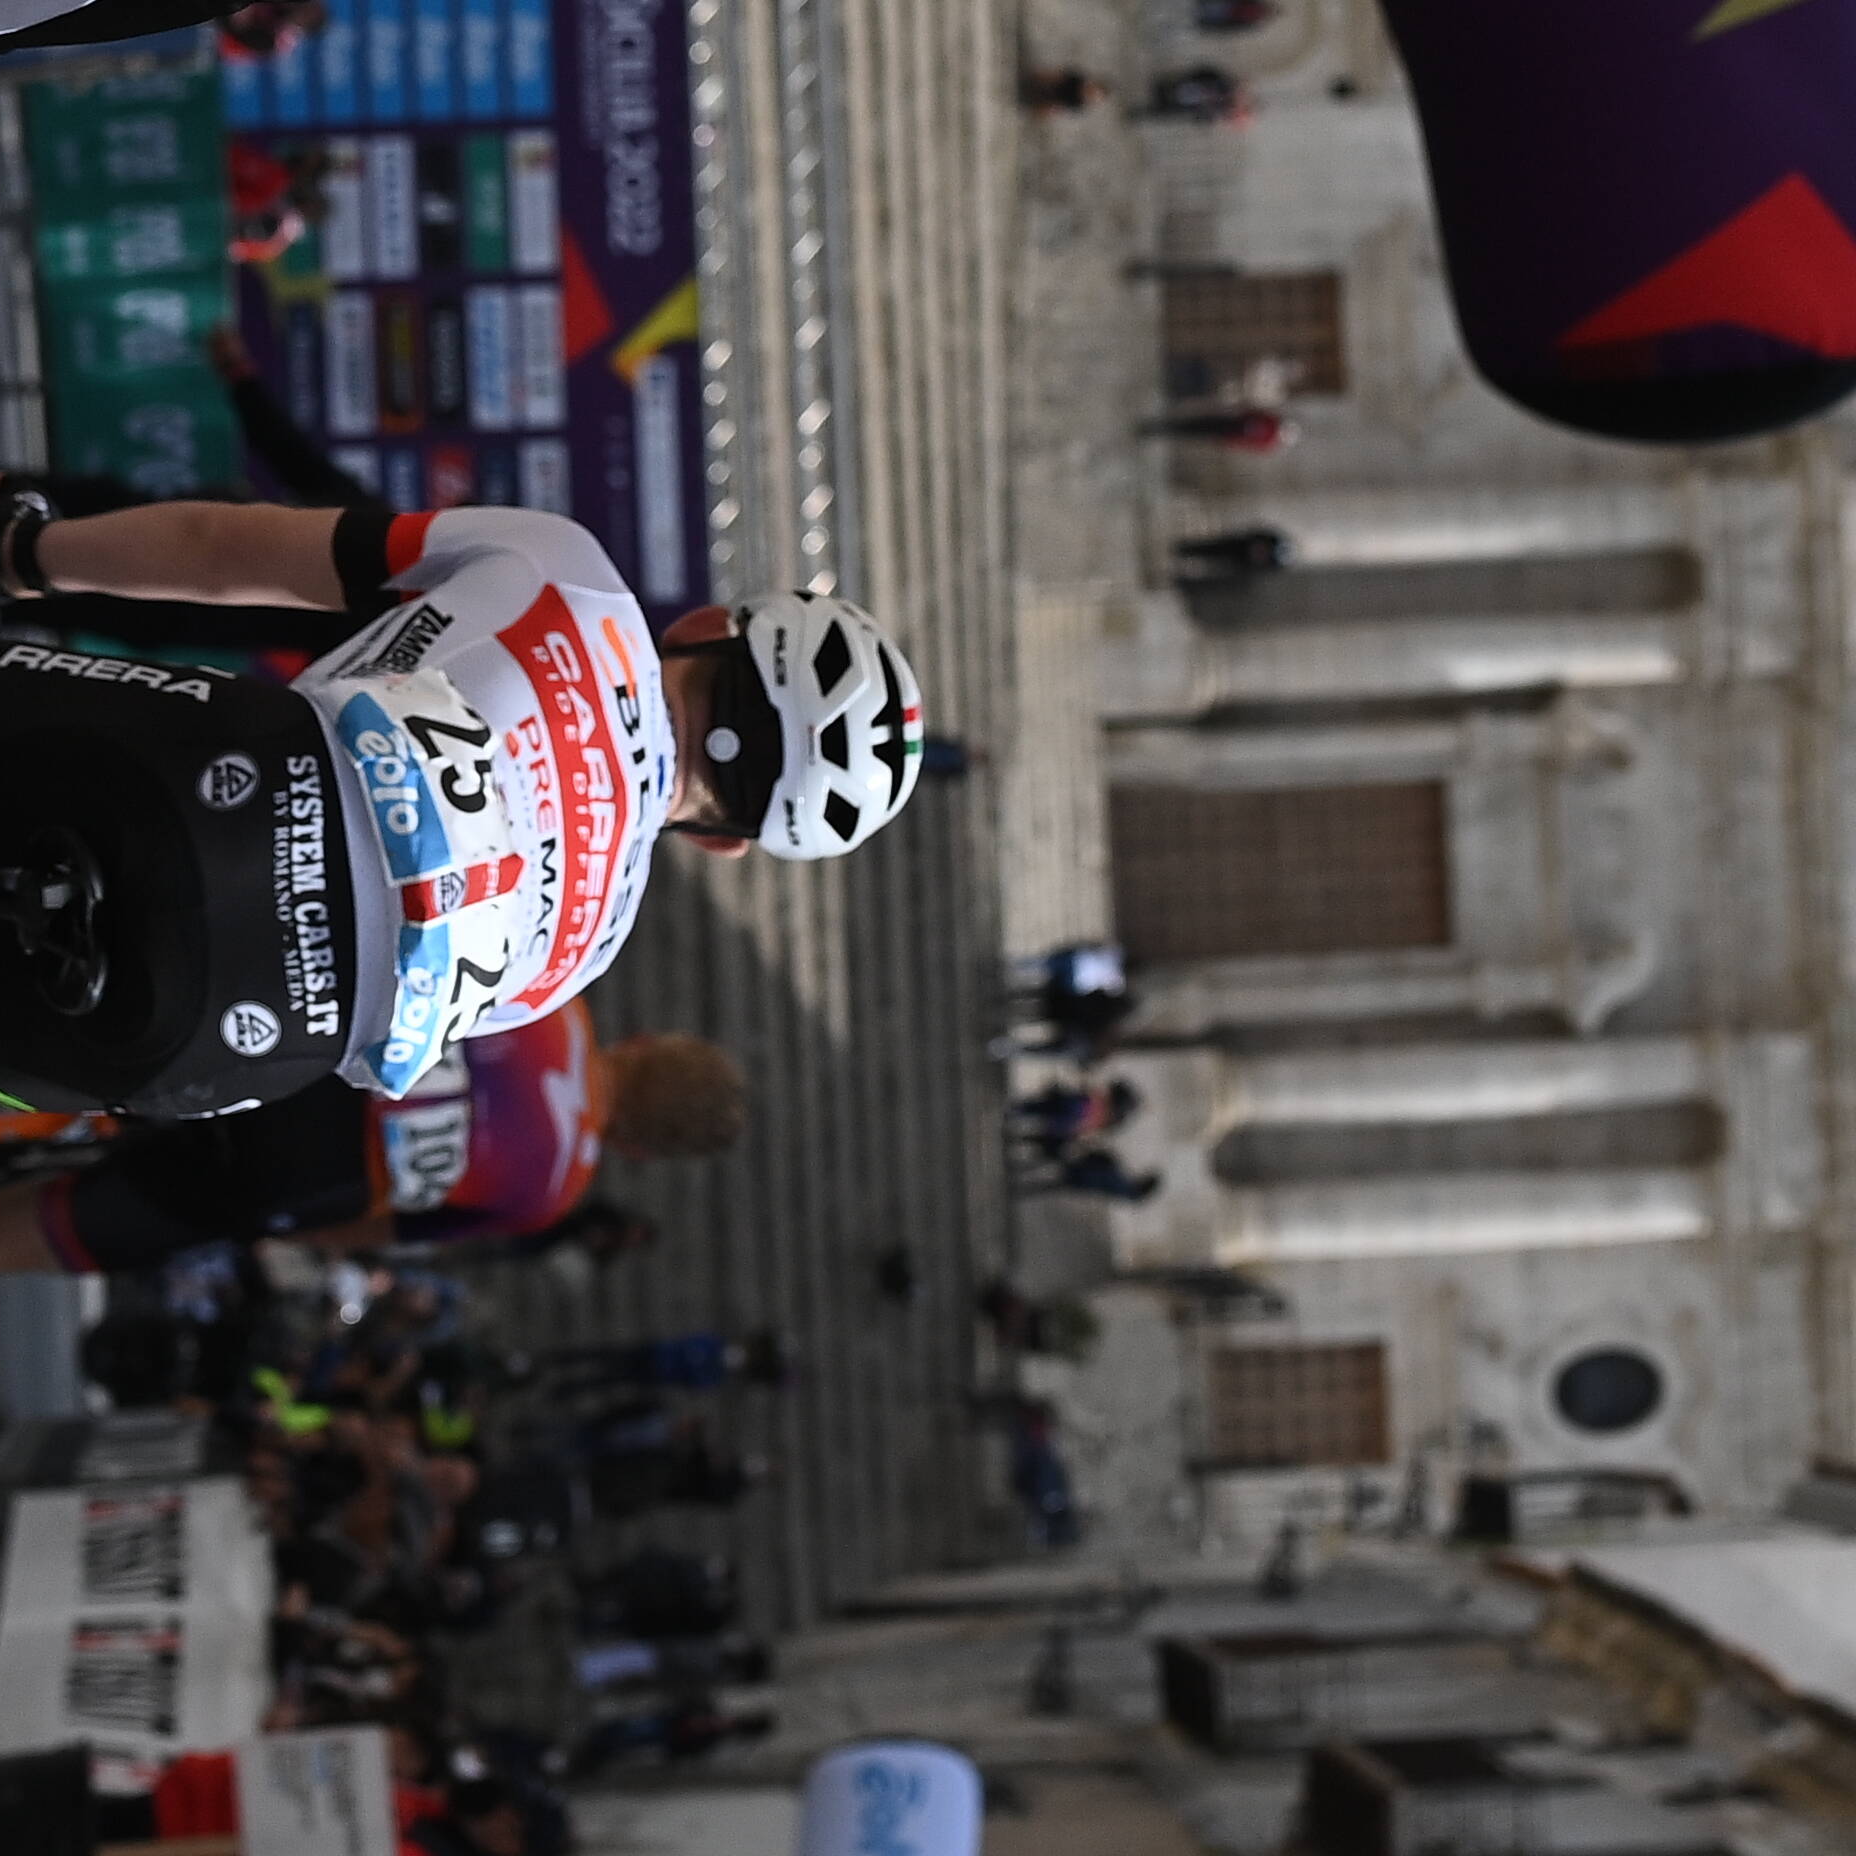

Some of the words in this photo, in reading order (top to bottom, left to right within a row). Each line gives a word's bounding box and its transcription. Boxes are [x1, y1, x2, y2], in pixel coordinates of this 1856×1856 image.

[403, 706, 492, 813] 25
[530, 644, 575, 745] RIDE
[286, 755, 326, 895] SYSTEM
[517, 716, 557, 957] PREMAC
[525, 631, 616, 992] CARRERA
[272, 791, 290, 818] BY
[283, 949, 305, 1012] MEDA
[293, 901, 339, 1037] CARS.IT
